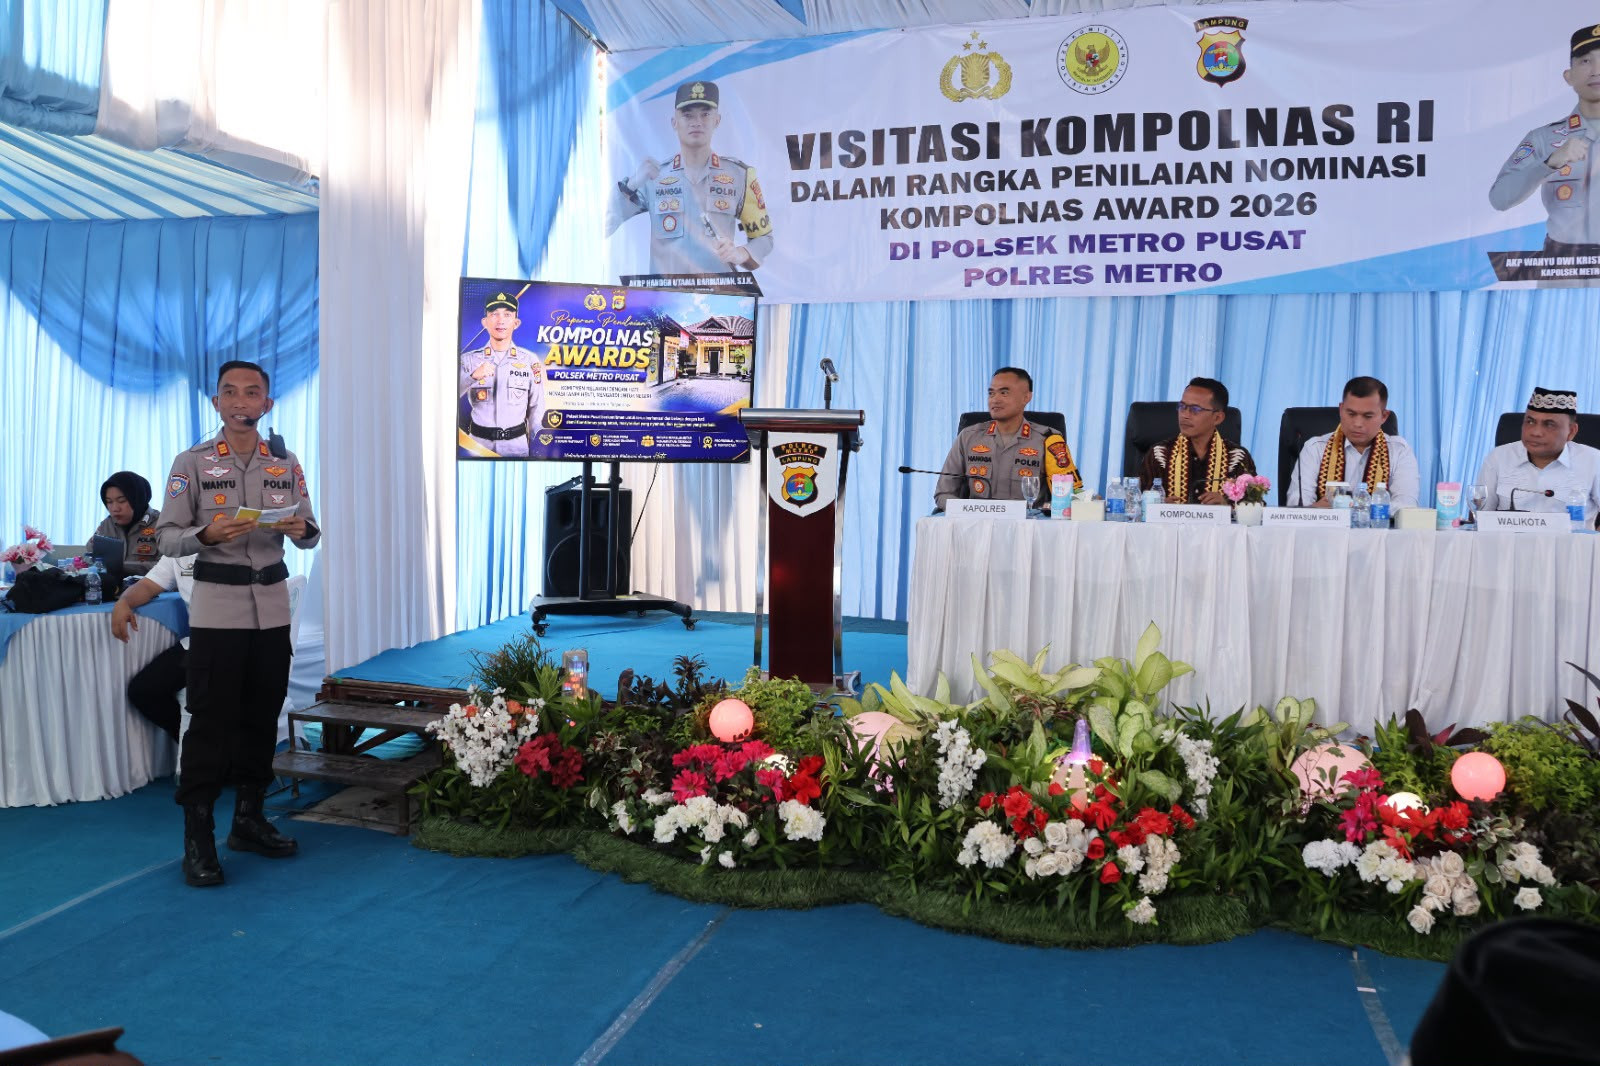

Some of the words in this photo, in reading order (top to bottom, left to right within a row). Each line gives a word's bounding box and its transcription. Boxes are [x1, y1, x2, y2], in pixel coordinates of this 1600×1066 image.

[1197, 19, 1245, 29] LAMPUNG
[785, 120, 1000, 171] VISITASI
[1020, 103, 1355, 158] KOMPOLNAS
[1376, 99, 1434, 144] RI
[790, 176, 896, 203] DALAM
[906, 168, 1041, 197] RANGKA
[1051, 160, 1233, 189] PENILAIAN
[1244, 154, 1426, 183] NOMINASI
[709, 186, 737, 197] POLRI
[880, 198, 1083, 230] KOMPOLNAS
[1092, 195, 1220, 220] AWARD
[1230, 191, 1318, 218] 2026
[889, 241, 921, 261] DI
[931, 234, 1057, 259] POLSEK
[1068, 232, 1185, 255] METRO
[1196, 229, 1307, 252] PUSAT
[1505, 258, 1523, 268] AKP
[1523, 257, 1555, 267] WAHYU
[1556, 256, 1575, 266] DWI
[963, 264, 1094, 288] POLRES
[1104, 262, 1223, 285] METRO
[1540, 267, 1578, 277] KAPOLSEK
[536, 325, 654, 348] KOMPOLNAS
[543, 343, 653, 369] AWARDS
[509, 370, 529, 378] POLRI
[553, 370, 586, 380] POLSEK
[586, 371, 614, 381] METRO
[614, 372, 640, 381] PUSAT
[781, 455, 818, 464] LAMPUNG
[1014, 458, 1040, 467] POLRI
[201, 479, 236, 490] WAHYU
[263, 479, 291, 490] POLRI
[962, 504, 1006, 513] KAPOLRES
[1160, 510, 1214, 520] KOMPOLNAS
[1497, 517, 1547, 526] WALIKOTA
